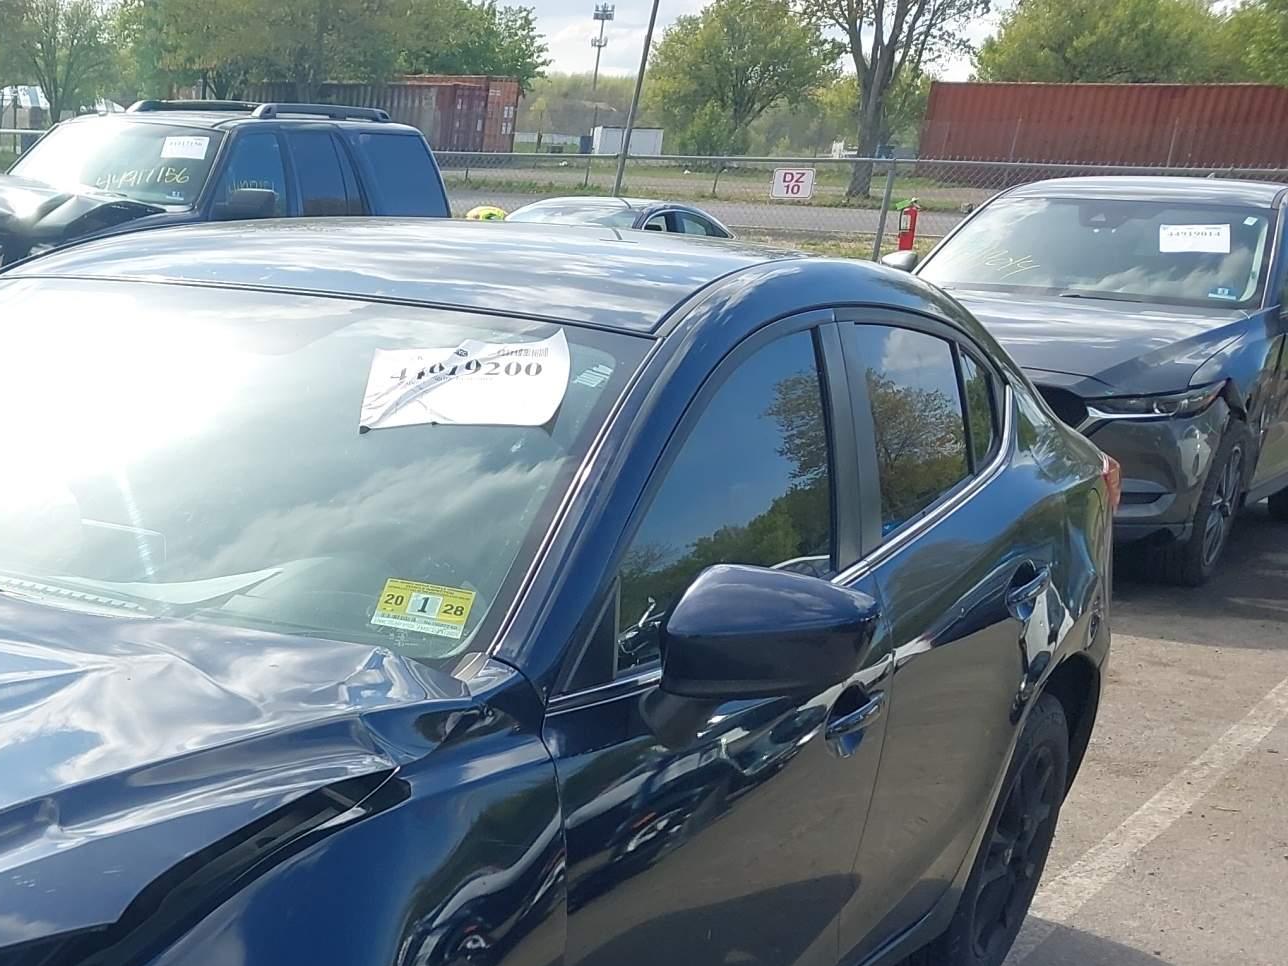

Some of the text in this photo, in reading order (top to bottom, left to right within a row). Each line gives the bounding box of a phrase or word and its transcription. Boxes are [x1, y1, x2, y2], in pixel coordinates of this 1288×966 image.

[96, 166, 190, 191] 44917156
[783, 172, 806, 184] DZ
[784, 184, 801, 195] 10
[383, 593, 465, 617] 20 1 28
